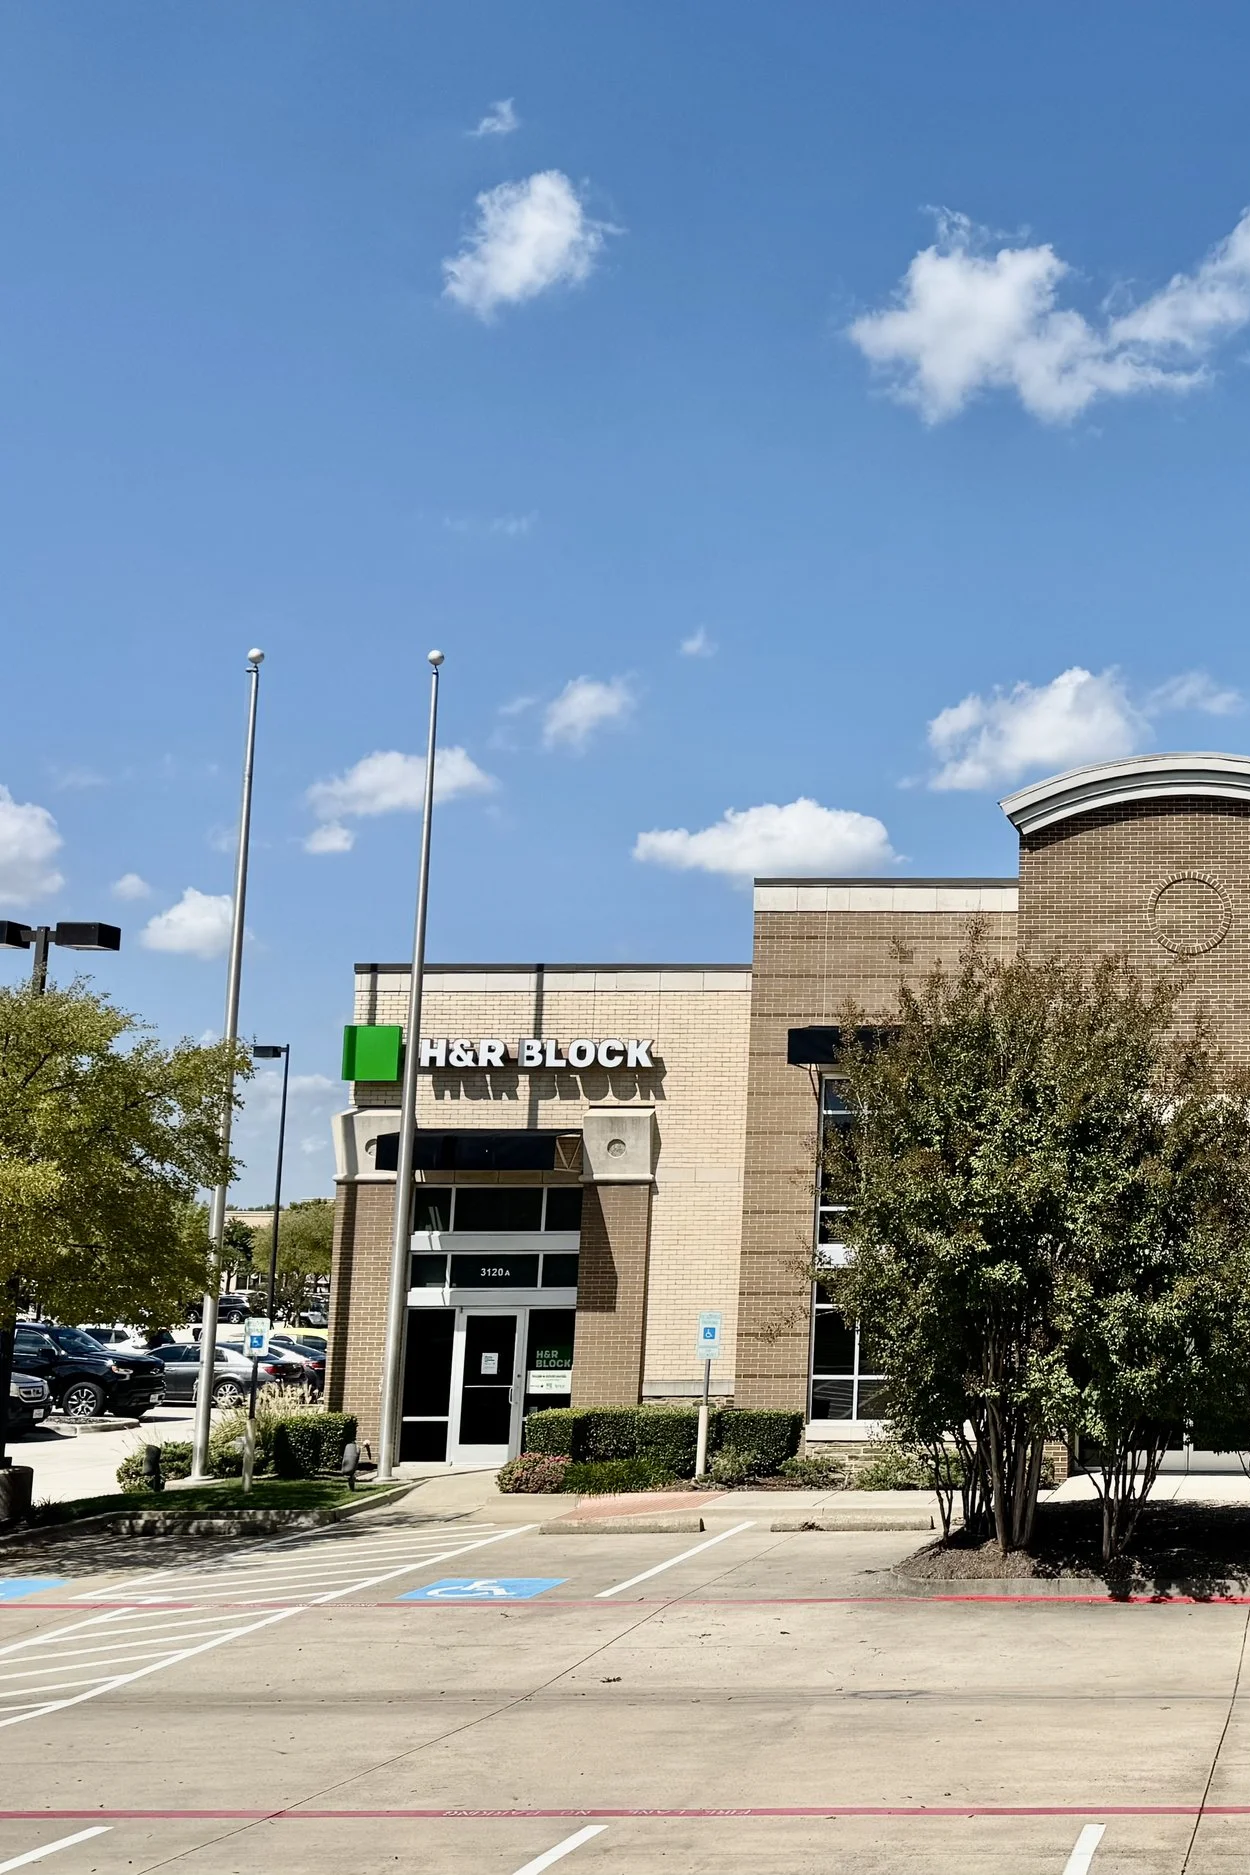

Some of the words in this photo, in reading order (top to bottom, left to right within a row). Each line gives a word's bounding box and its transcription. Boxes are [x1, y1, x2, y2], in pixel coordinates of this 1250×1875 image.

[419, 1038, 505, 1067] H&R
[518, 1038, 654, 1068] BLOCK
[536, 1350, 559, 1359] H&R
[535, 1359, 571, 1368] BLOCK
